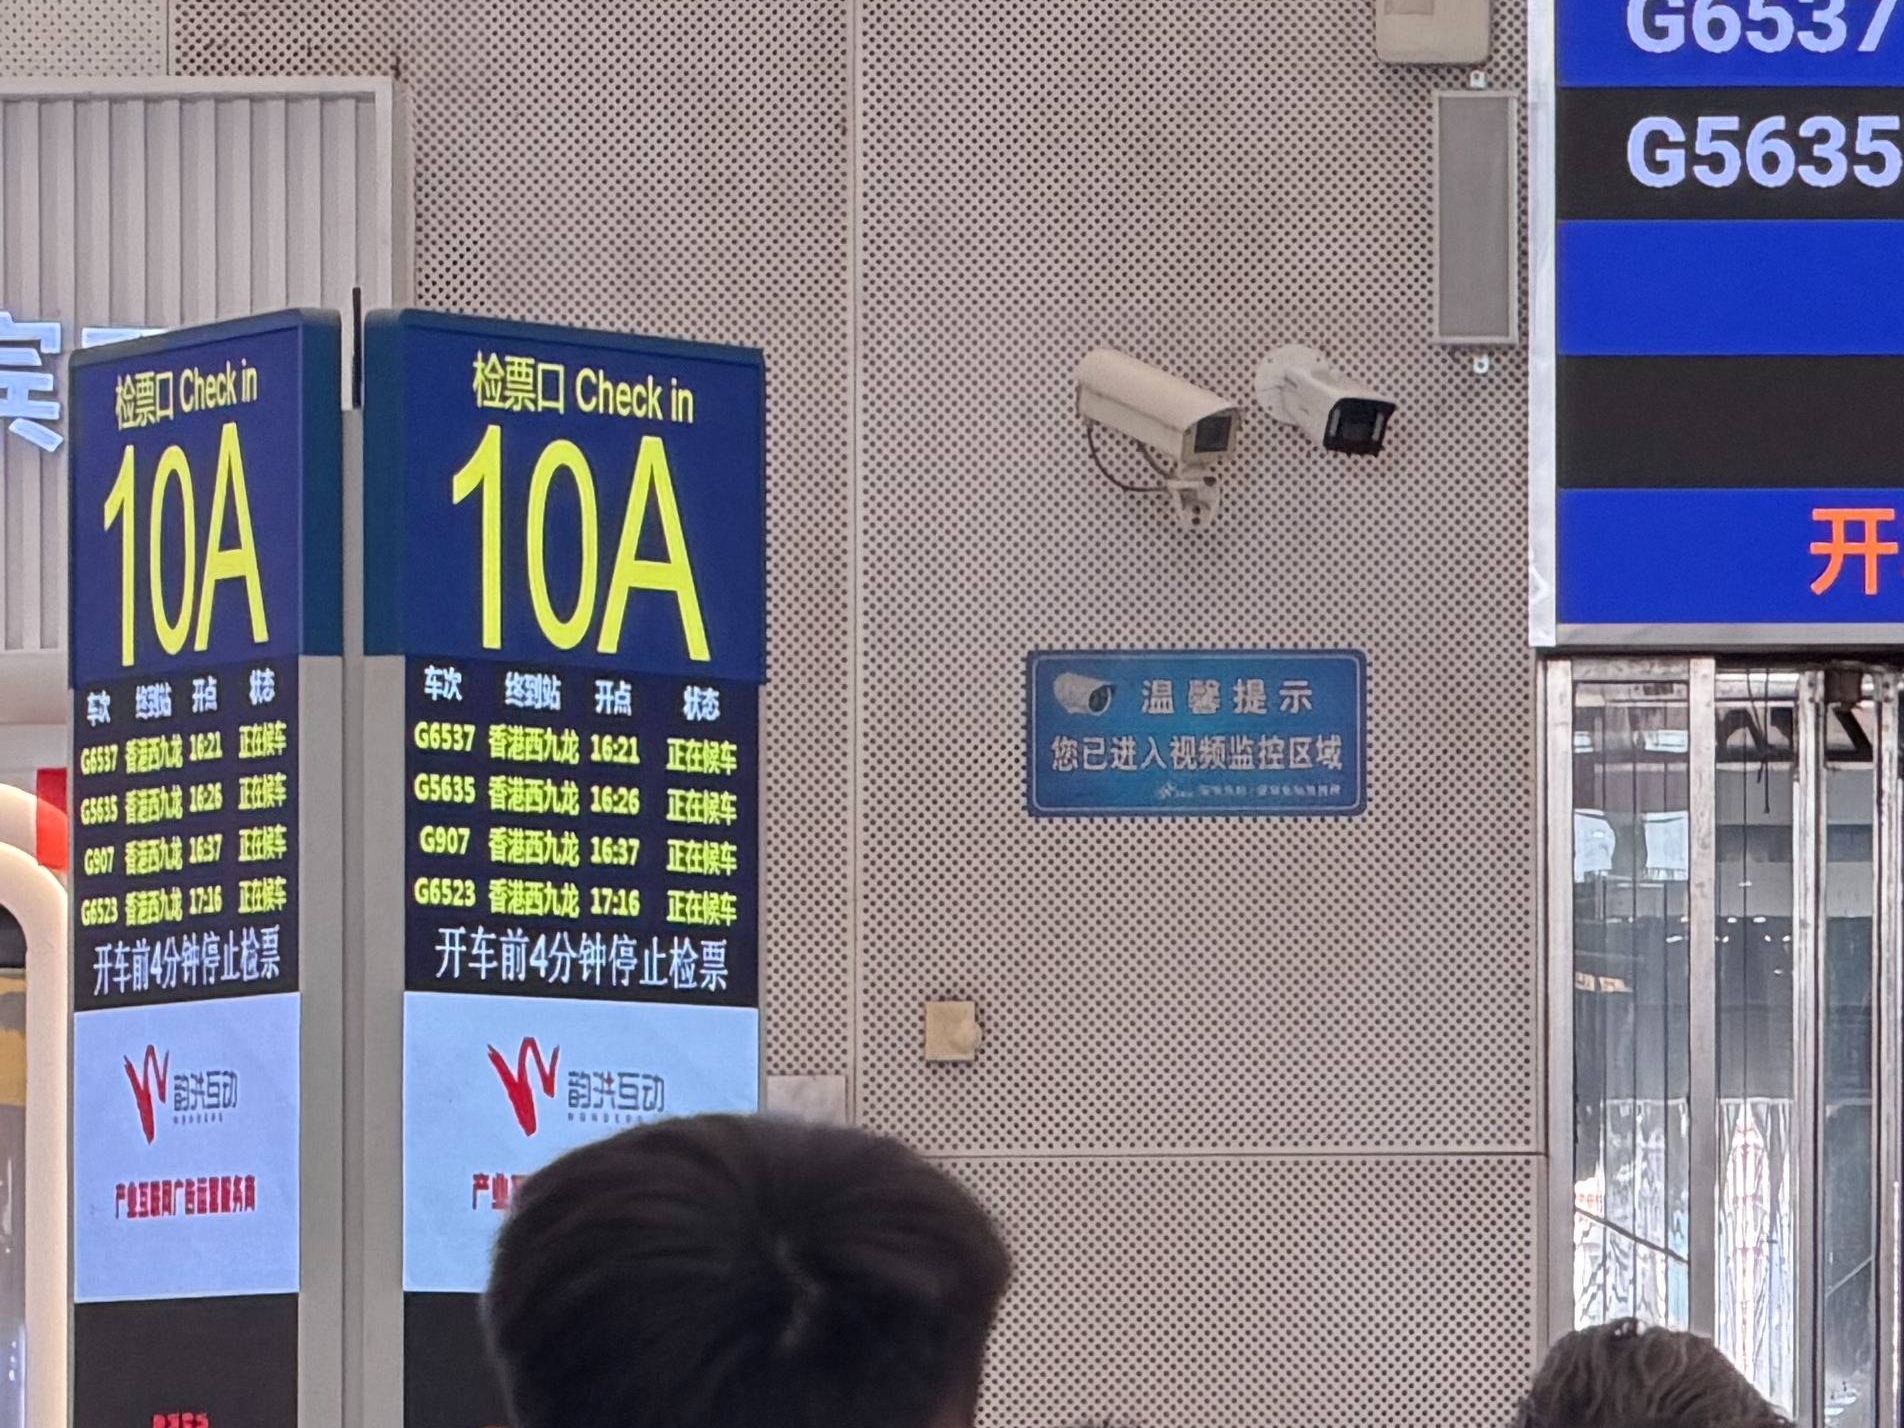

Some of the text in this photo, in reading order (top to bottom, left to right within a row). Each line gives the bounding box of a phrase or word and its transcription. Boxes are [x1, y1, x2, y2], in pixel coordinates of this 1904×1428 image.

[1627, 116, 1903, 188] G5635
[115, 358, 257, 431] 检票口 Check in
[473, 349, 693, 424] 检票口 Check in
[104, 422, 270, 667] 10A
[451, 424, 712, 663] 10A
[192, 676, 218, 713] 开点
[424, 665, 720, 721] 车次 终到站 开点 状态
[1141, 679, 1312, 714] 温馨提示
[81, 721, 287, 775] G6537 香港西九龙 16:21 正在候车
[414, 722, 738, 775] G6537 香港西九龙 16:21 正在候车
[1051, 734, 1344, 771] 您已进入视频监控区域
[81, 772, 287, 825] G5635 香港西九龙 16:26 正在候车
[414, 773, 738, 826] G5635 香港西九龙 16:26 正在候车
[84, 824, 287, 876] G907 香港西九龙 16:37 正在候车
[420, 826, 738, 876] G907 香港西九龙 16:37 正在候车
[81, 876, 287, 927] G6523 香港西九龙 17:16 正在候车
[414, 877, 738, 926] G6523 香港西九龙 17:16 正在候车
[93, 924, 280, 996] 开车前4分钟停止检票
[435, 925, 729, 992] 开车前4分钟停止检票
